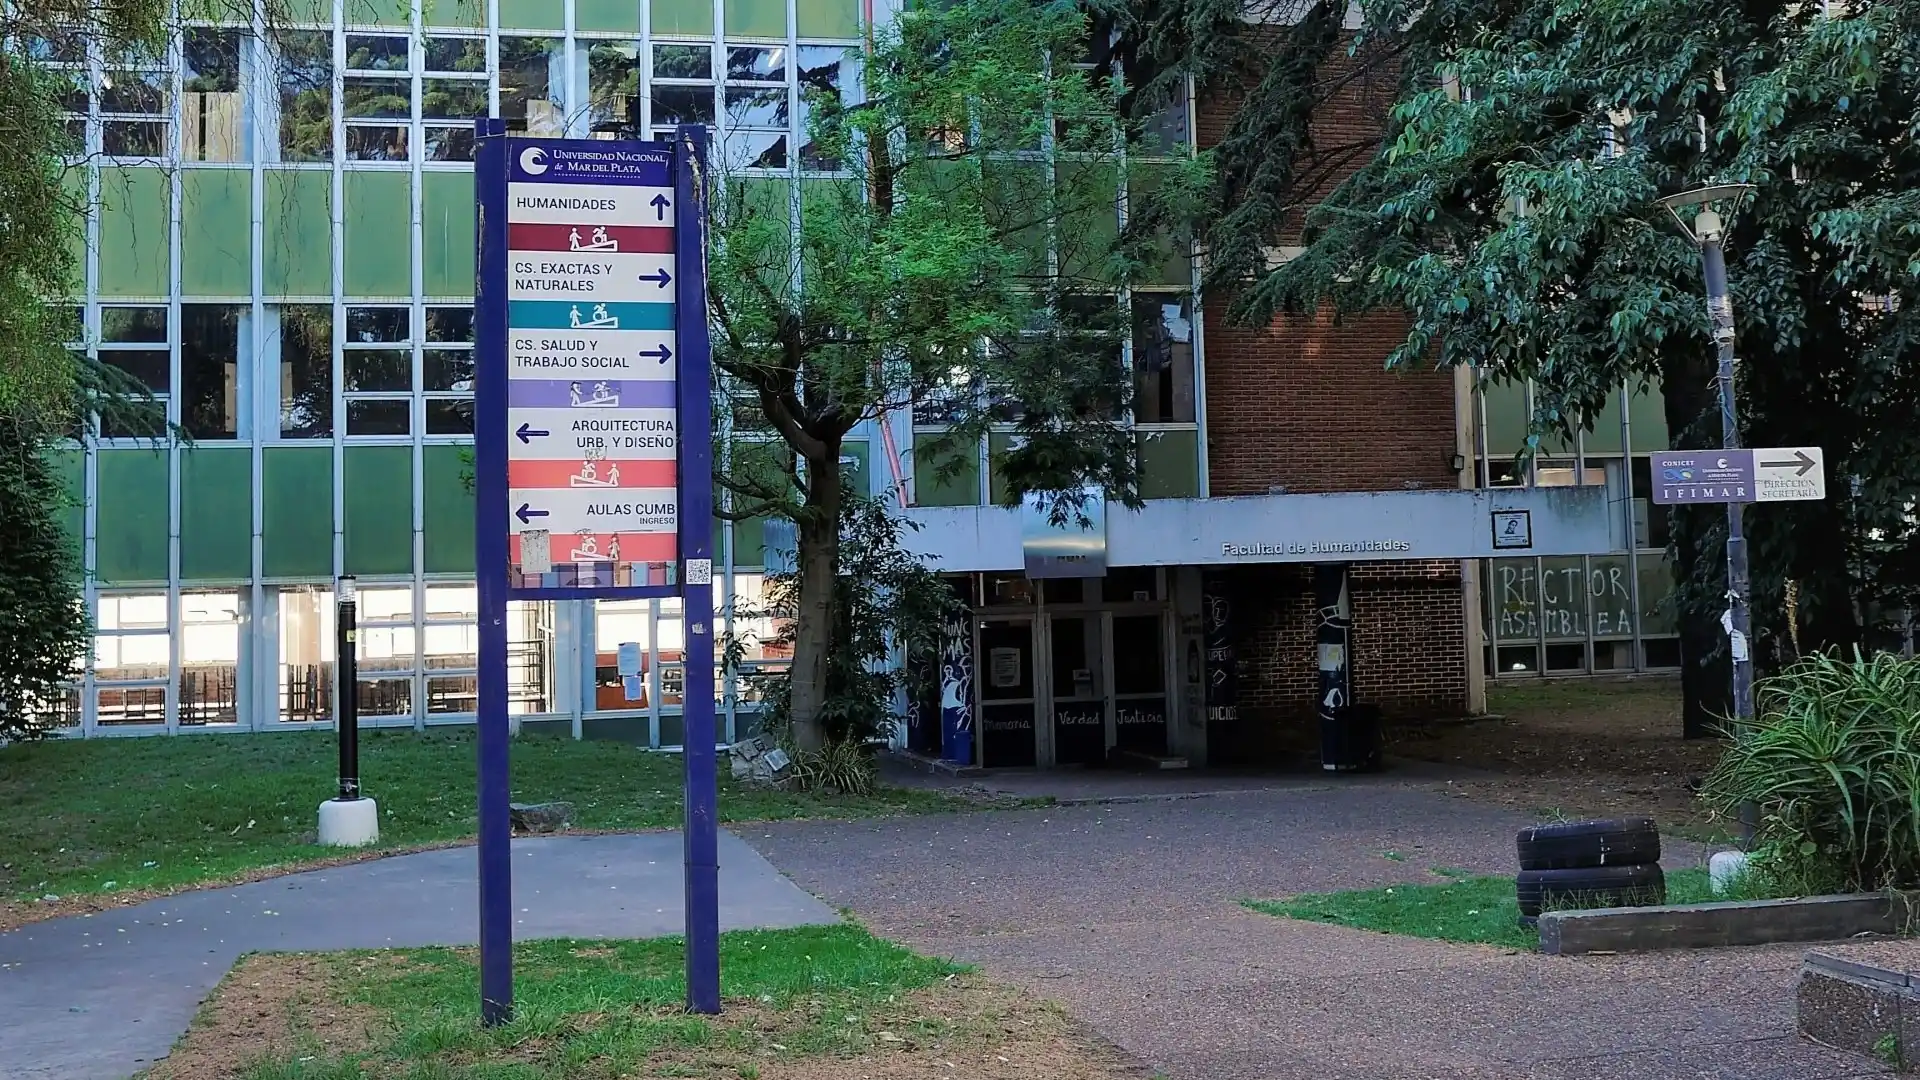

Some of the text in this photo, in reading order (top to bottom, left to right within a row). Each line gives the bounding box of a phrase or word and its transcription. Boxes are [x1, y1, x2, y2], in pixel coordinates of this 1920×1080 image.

[516, 197, 616, 211] HUMANIDADES
[515, 262, 613, 275] CS. EXACTAS Y
[515, 279, 594, 291] NATURALES
[515, 339, 598, 351] CS. SALUD Y
[515, 356, 630, 368] TRABAJO SOCIAL
[571, 420, 674, 432] ARQUITECTURA
[576, 434, 674, 448] URB. Y DISEÑO
[586, 503, 676, 515] AULAS CUMB
[639, 517, 675, 525] INGRESO
[1222, 539, 1410, 556] Facultad de Humanidades
[1498, 565, 1629, 606] RECTOR
[1500, 608, 1632, 636] ASAMBLEA
